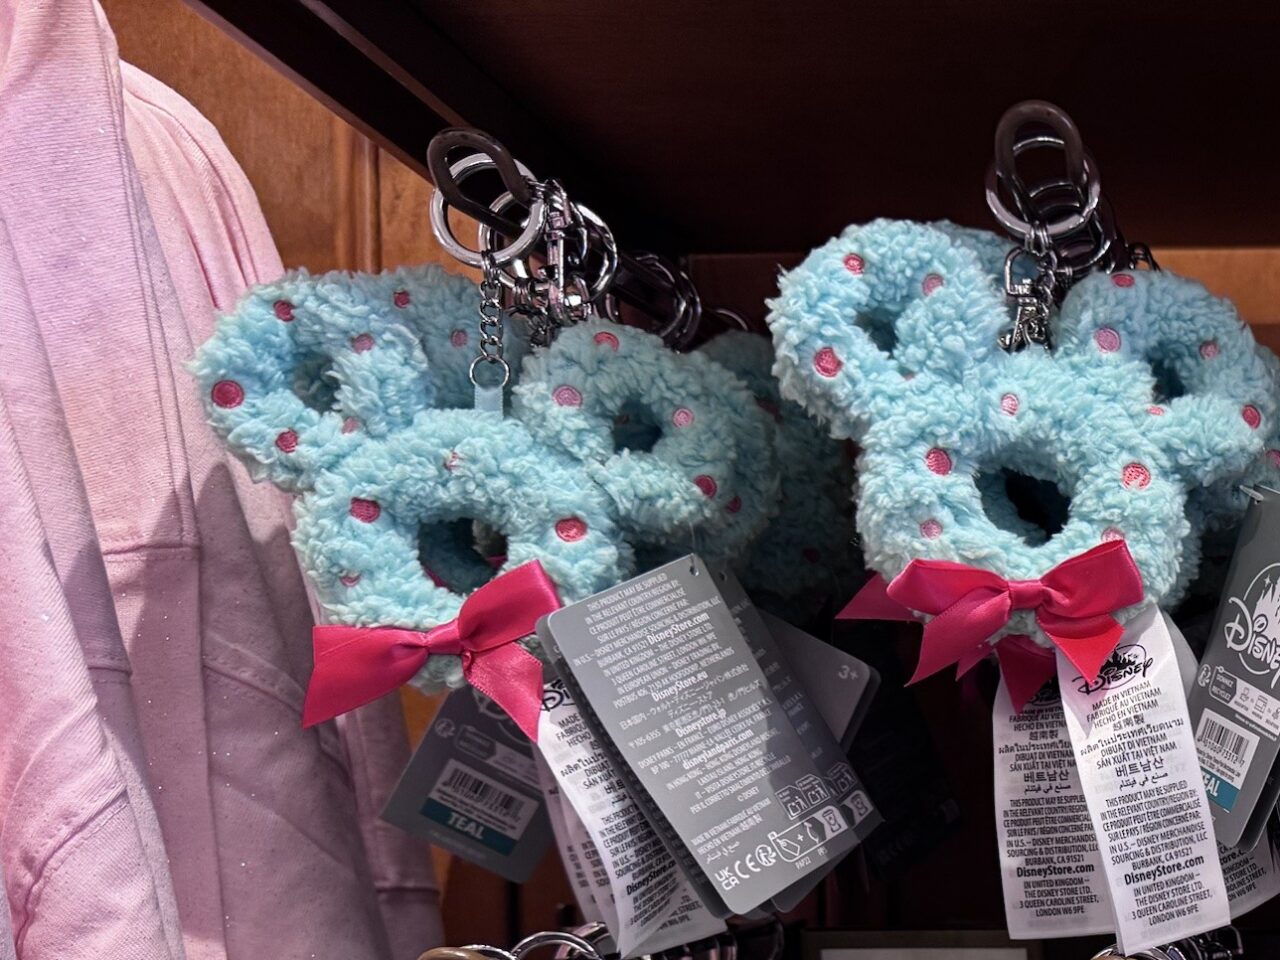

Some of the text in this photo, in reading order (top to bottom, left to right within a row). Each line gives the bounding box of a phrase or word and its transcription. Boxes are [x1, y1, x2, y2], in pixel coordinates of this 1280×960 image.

[646, 609, 710, 646] DisneyStore.com
[650, 668, 710, 704] DisneyStore.eu
[1092, 680, 1152, 711] MADE IN VIETNAM
[1087, 687, 1162, 723] FABRIQUÉ AU VIETNAM
[1093, 699, 1159, 729] HECHO EN VIETNAM
[674, 706, 728, 739] Disneystore.jp
[680, 728, 756, 771] disneylandparis.com
[1100, 731, 1168, 758] DIBUAT DI VIETNAM
[1114, 754, 1166, 779] 베트남산
[1105, 778, 1188, 809] THIS PRODUCT MAY BE SUPPLIED
[447, 811, 485, 840] TEAL
[1109, 844, 1117, 854] IN
[1136, 833, 1160, 847] DISNEY
[1159, 821, 1205, 840] MERCHANDISE
[1024, 854, 1084, 866] BURBANK, CA 91521
[1111, 831, 1208, 865] SOURCING & DISTRIBUTION, LLC
[1131, 846, 1193, 871] BURBANK, CA 91521
[1016, 864, 1094, 879] DisneyStore.com
[1023, 877, 1084, 889] IN UNITED KINGDOM
[1123, 853, 1205, 888] DisneyStore.com
[1133, 872, 1195, 897] IN UNITED KINGDOM
[1131, 888, 1212, 920] 3 QUEEN CAROLINE STREET,
[1135, 880, 1204, 907] THE DISNEY STORE LTD.
[1148, 903, 1199, 925] LONDON W6 9PE
